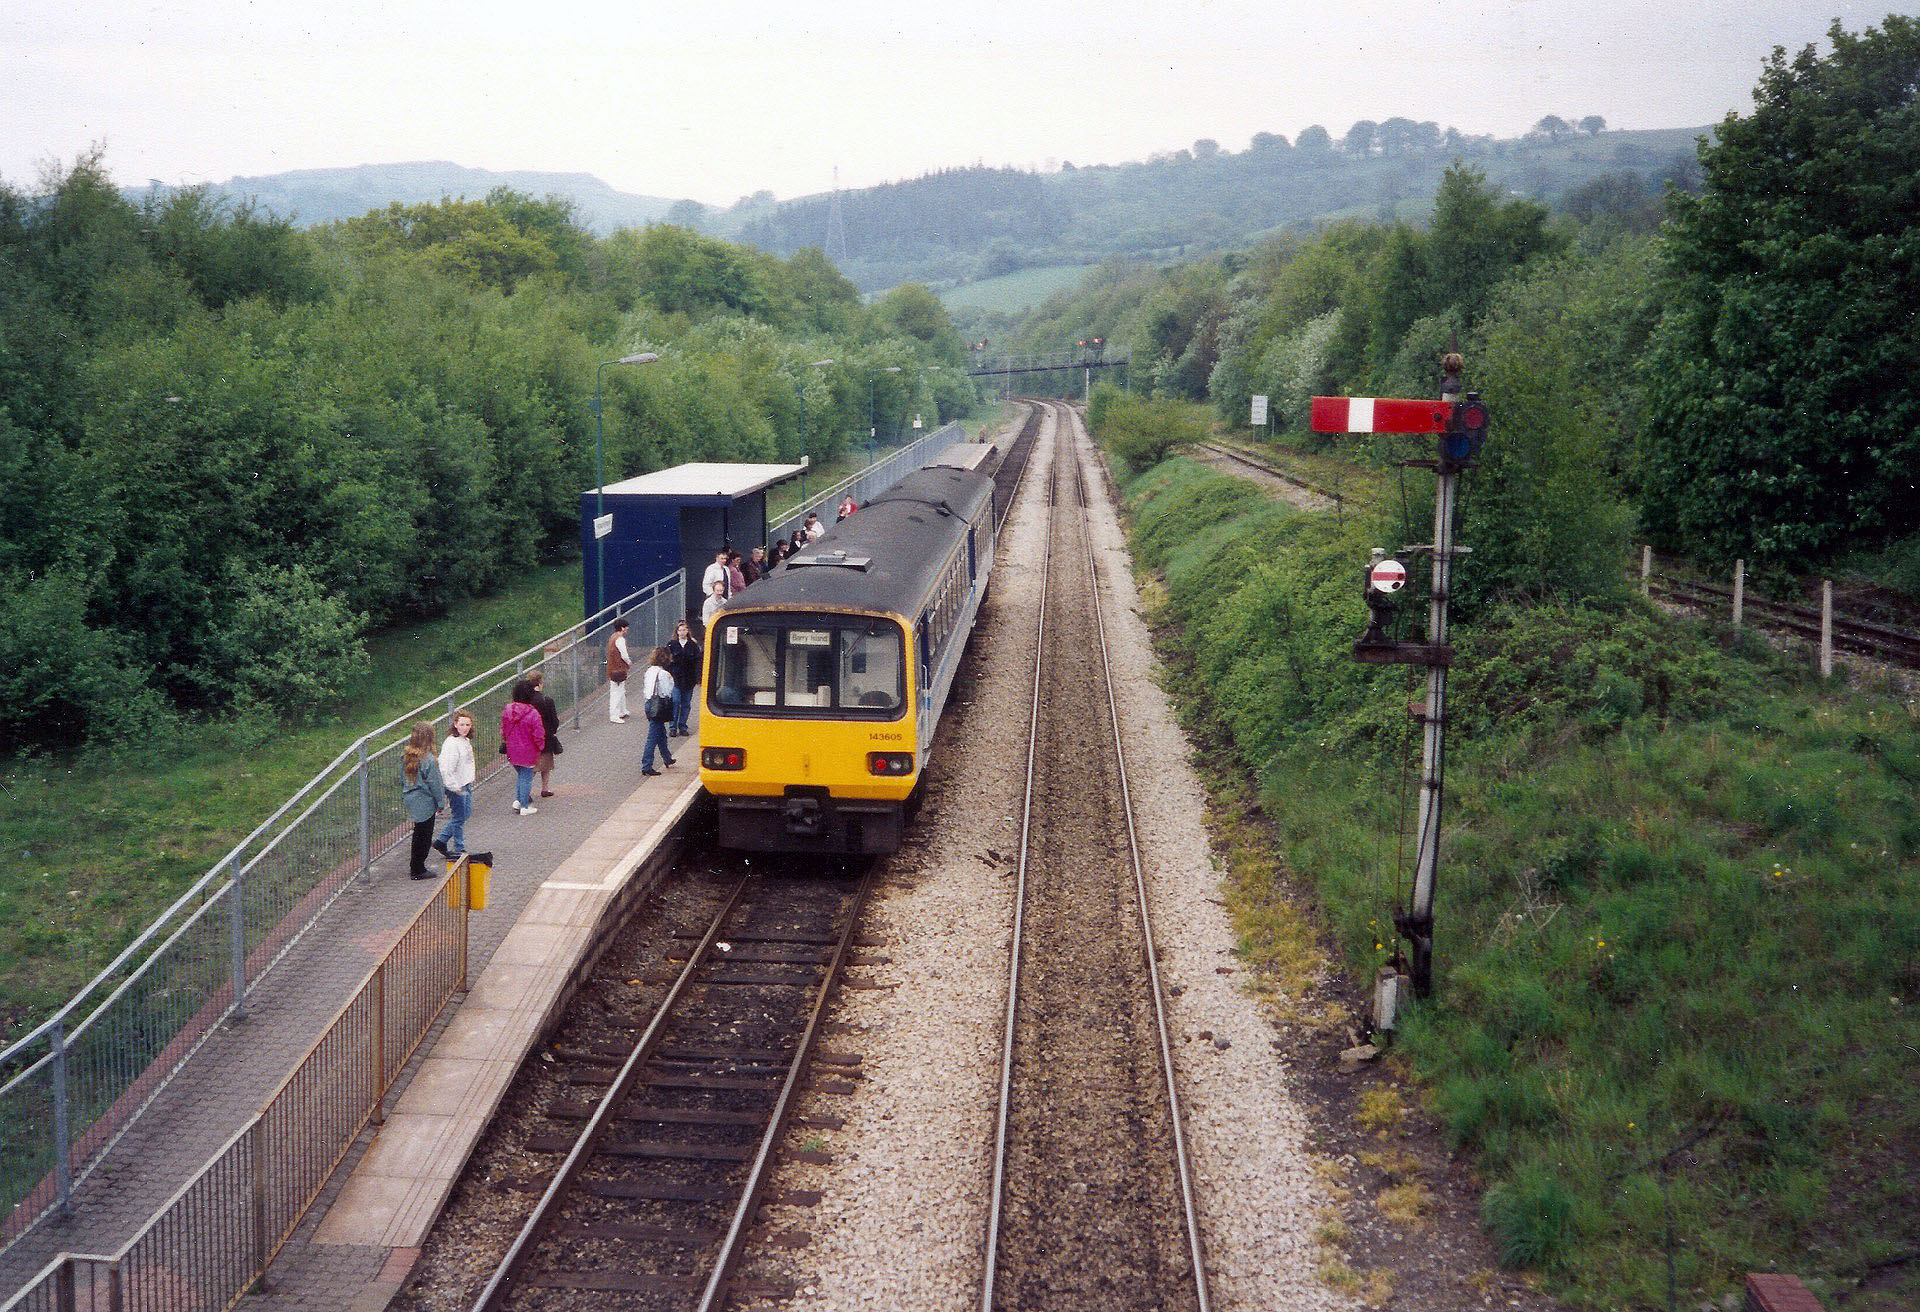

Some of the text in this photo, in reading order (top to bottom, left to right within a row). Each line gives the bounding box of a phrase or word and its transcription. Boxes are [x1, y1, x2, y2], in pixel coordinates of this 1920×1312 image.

[792, 633, 828, 642] Barry Island
[869, 733, 902, 741] 143605
